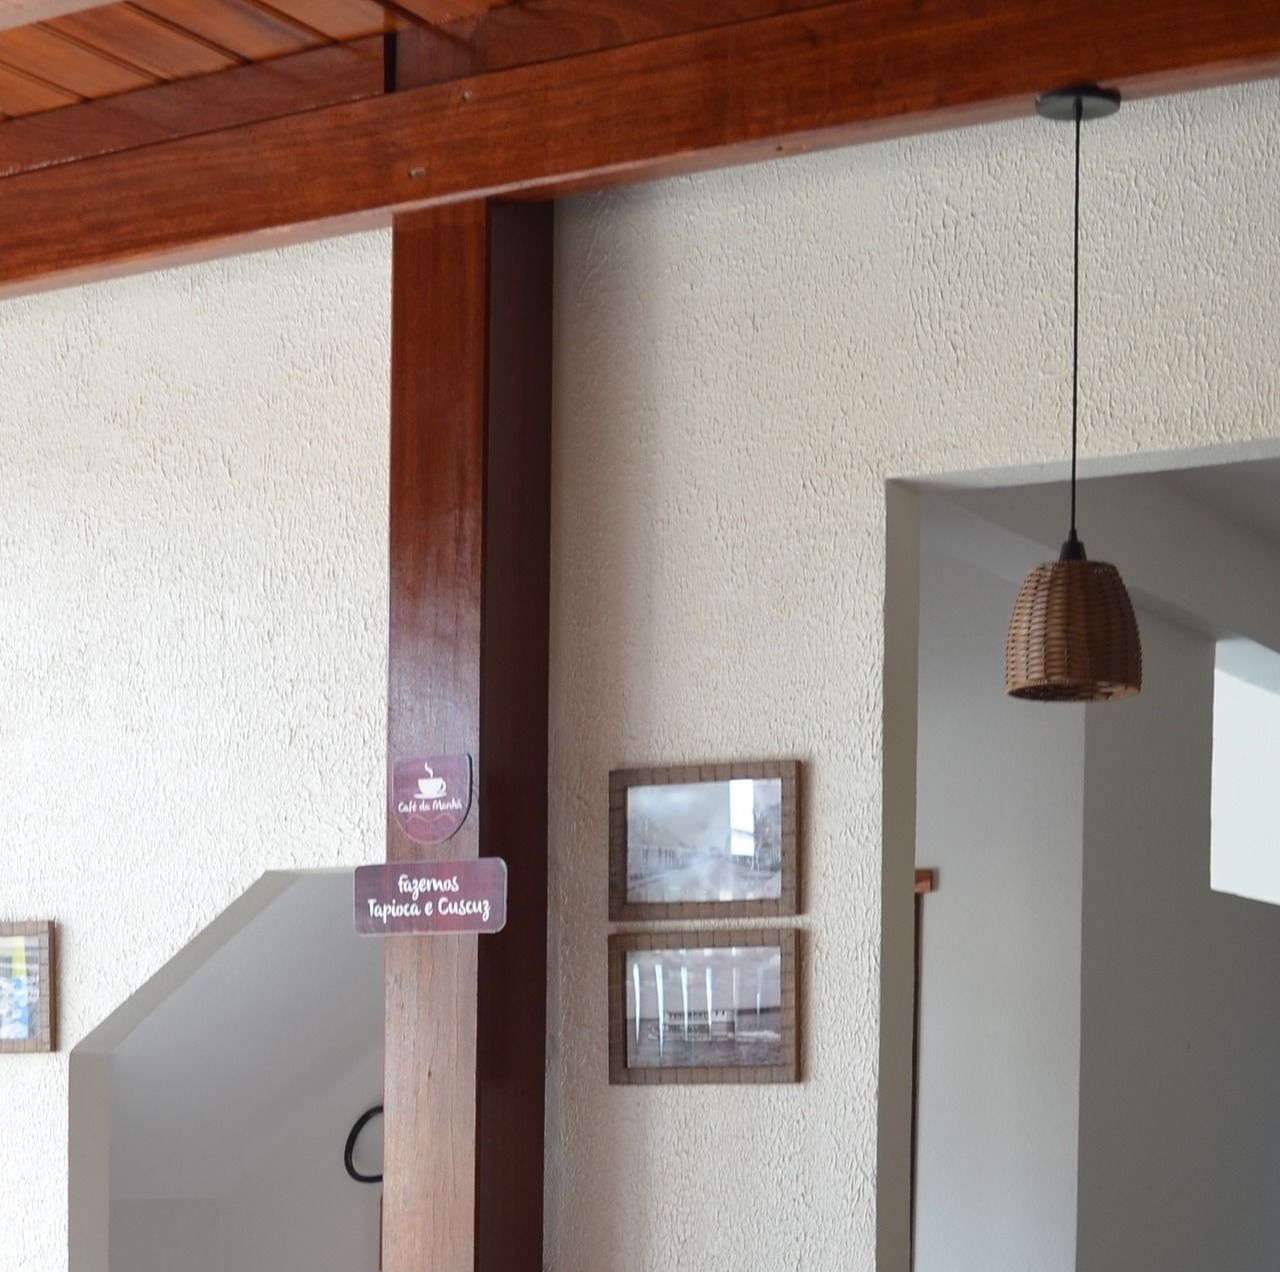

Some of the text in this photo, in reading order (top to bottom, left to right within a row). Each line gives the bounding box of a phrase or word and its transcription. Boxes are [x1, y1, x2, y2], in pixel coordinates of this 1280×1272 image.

[398, 799, 417, 813] Café
[419, 800, 430, 811] da
[368, 896, 491, 924] Tapioca e Cuscuz
